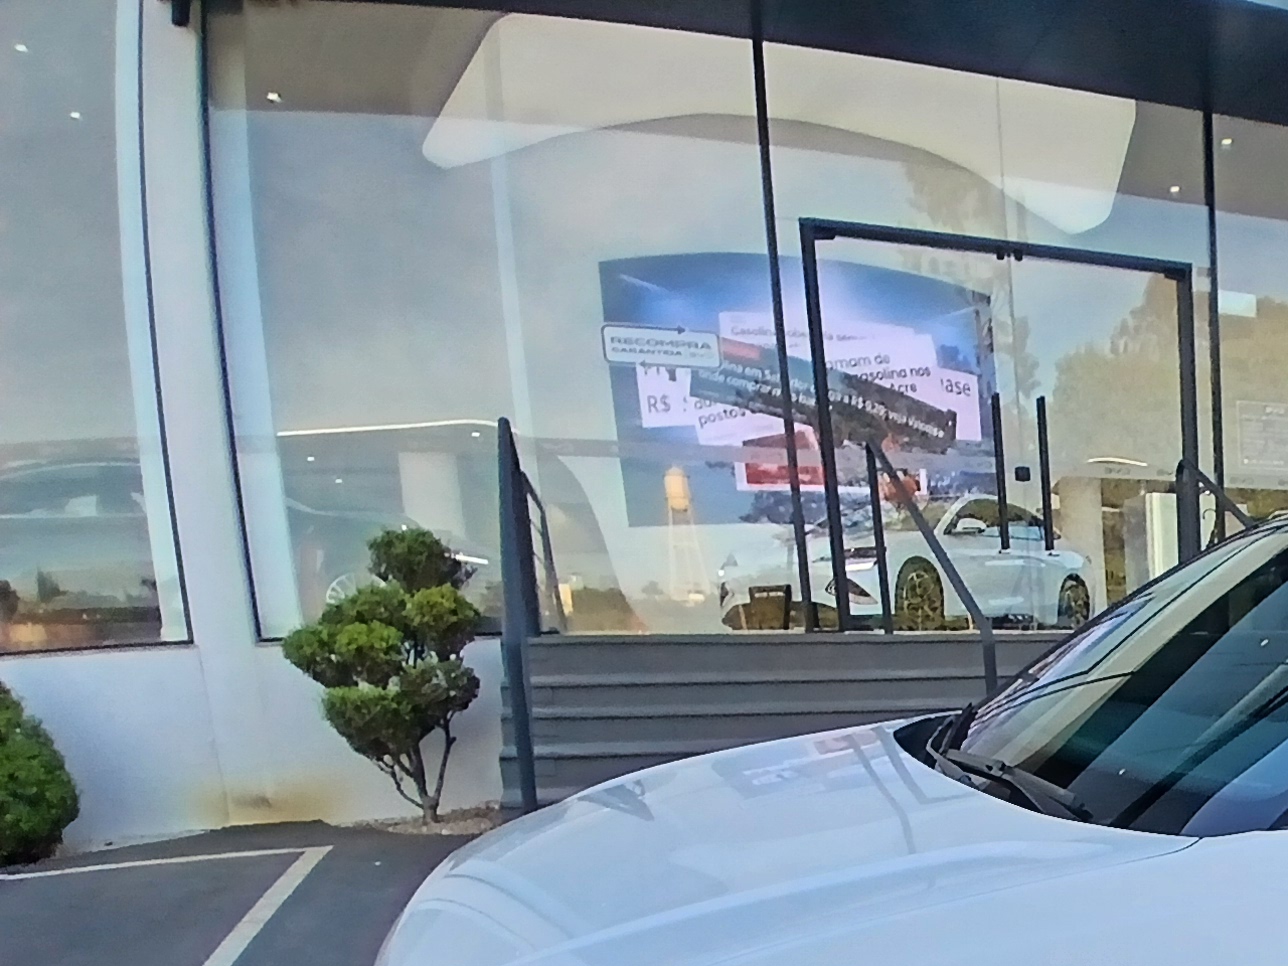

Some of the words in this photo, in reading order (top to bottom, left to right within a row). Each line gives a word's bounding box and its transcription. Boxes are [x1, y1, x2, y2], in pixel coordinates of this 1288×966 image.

[610, 336, 712, 350] RECOMPRA
[910, 366, 931, 377] nos
[647, 394, 671, 413] R$
